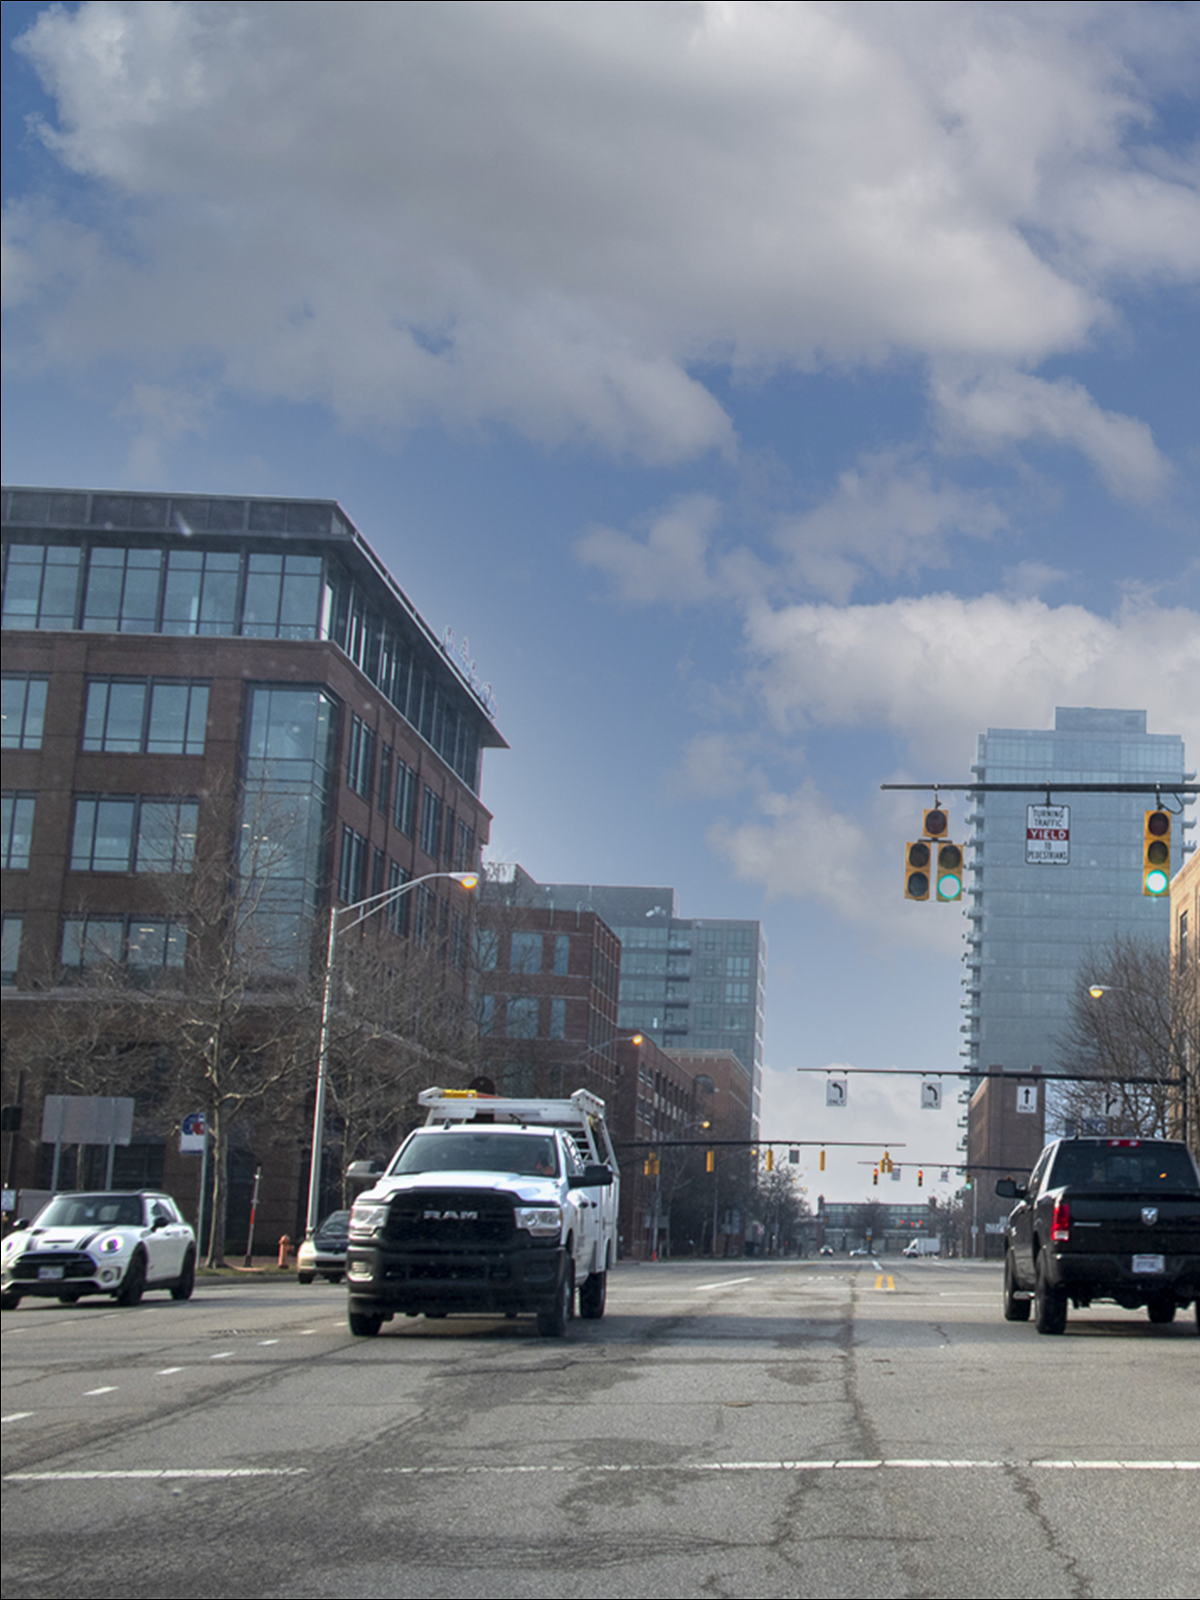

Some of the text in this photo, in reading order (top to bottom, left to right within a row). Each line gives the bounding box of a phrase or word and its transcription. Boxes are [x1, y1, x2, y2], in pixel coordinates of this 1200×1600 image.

[1033, 810, 1064, 818] TURNING
[1034, 819, 1062, 827] TRAFFIC
[1030, 829, 1066, 839] YIELD
[1044, 842, 1052, 850] TO
[1028, 851, 1067, 860] PEDESTRIANS
[423, 1210, 479, 1220] RAM
